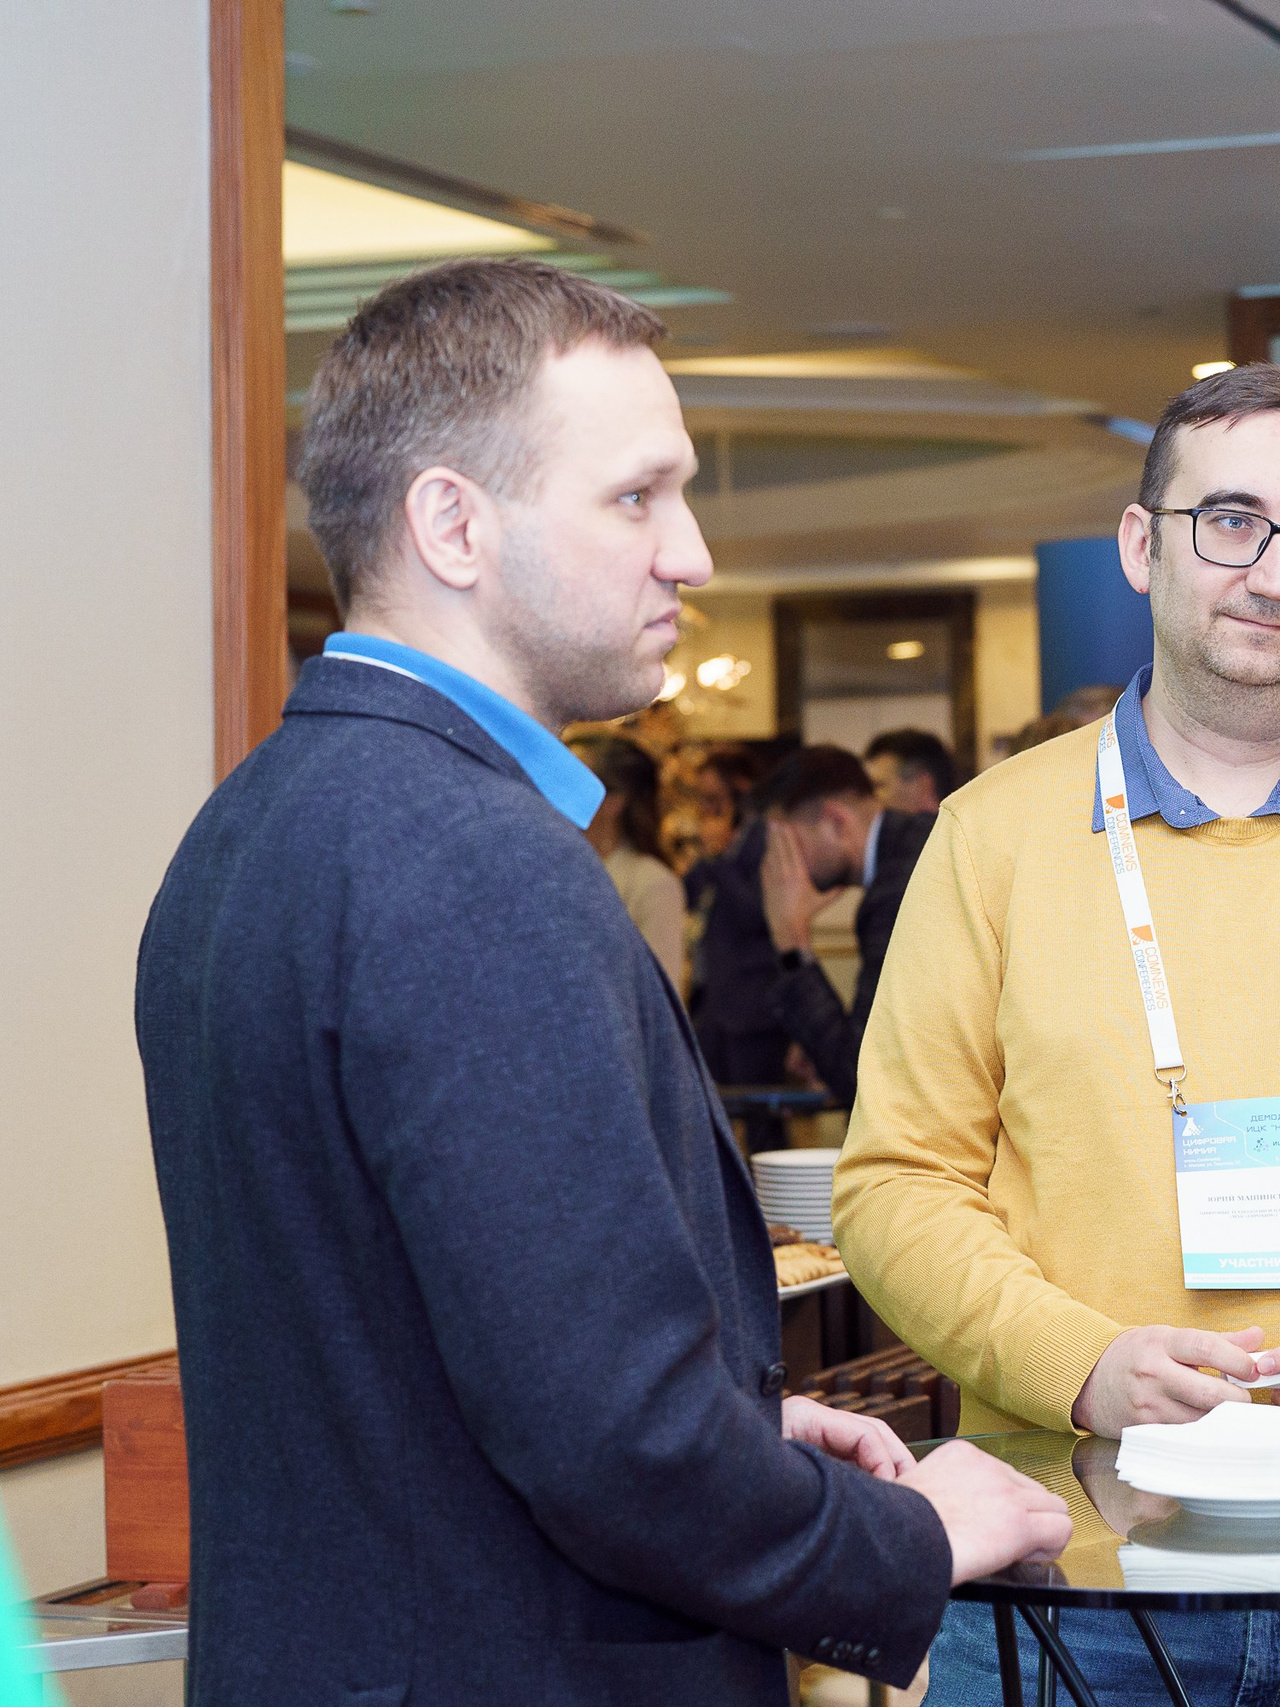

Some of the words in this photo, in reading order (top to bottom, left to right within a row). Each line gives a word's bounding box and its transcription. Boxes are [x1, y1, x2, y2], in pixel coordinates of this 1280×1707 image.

[1106, 816, 1125, 875] CONFERENCES
[1115, 812, 1138, 872] COMNEWS
[1134, 949, 1156, 1012] CONFERENCES
[1144, 946, 1169, 1009] COMNEWS
[1182, 1135, 1236, 1147] ЦИФРОВАЯ
[1207, 1194, 1236, 1203] ЮРИЙ
